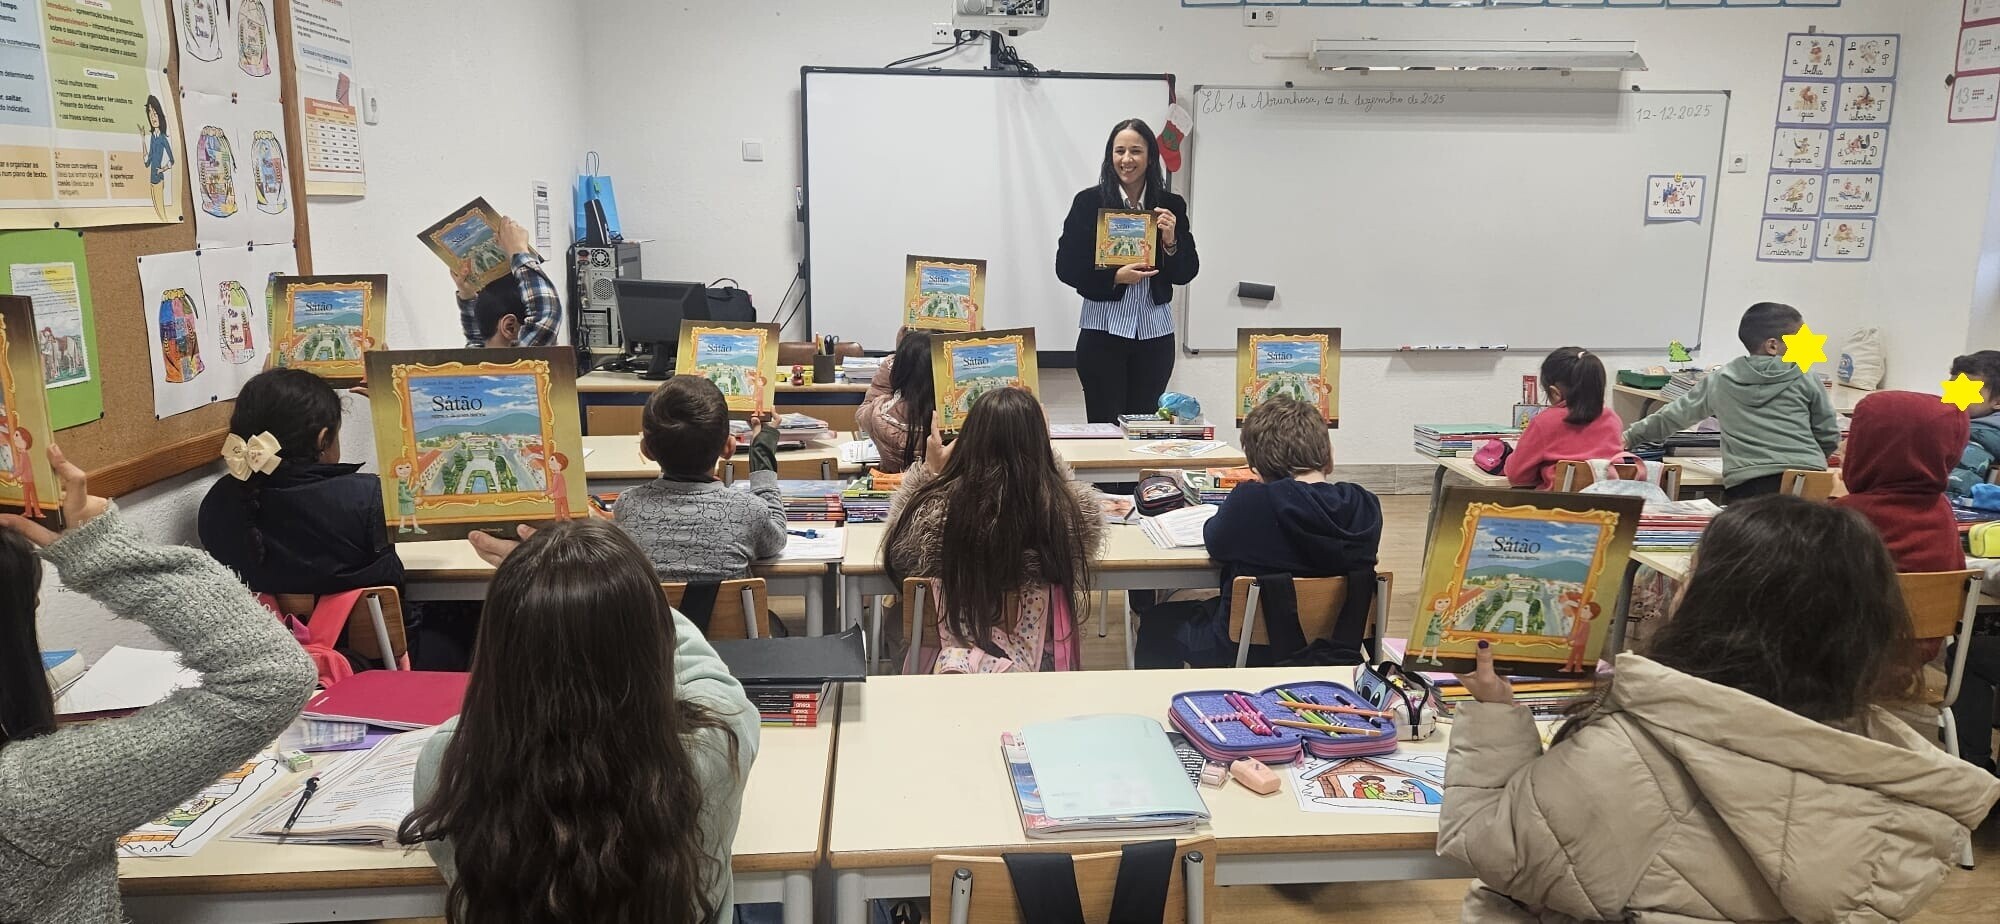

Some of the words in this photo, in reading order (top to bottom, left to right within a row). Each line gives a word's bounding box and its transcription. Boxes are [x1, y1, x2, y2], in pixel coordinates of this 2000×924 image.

[1420, 92, 1447, 105] 2025
[1798, 112, 1815, 122] gua
[1786, 158, 1813, 168] guana
[432, 395, 483, 412] Sátão
[1491, 536, 1541, 554] Sátão
